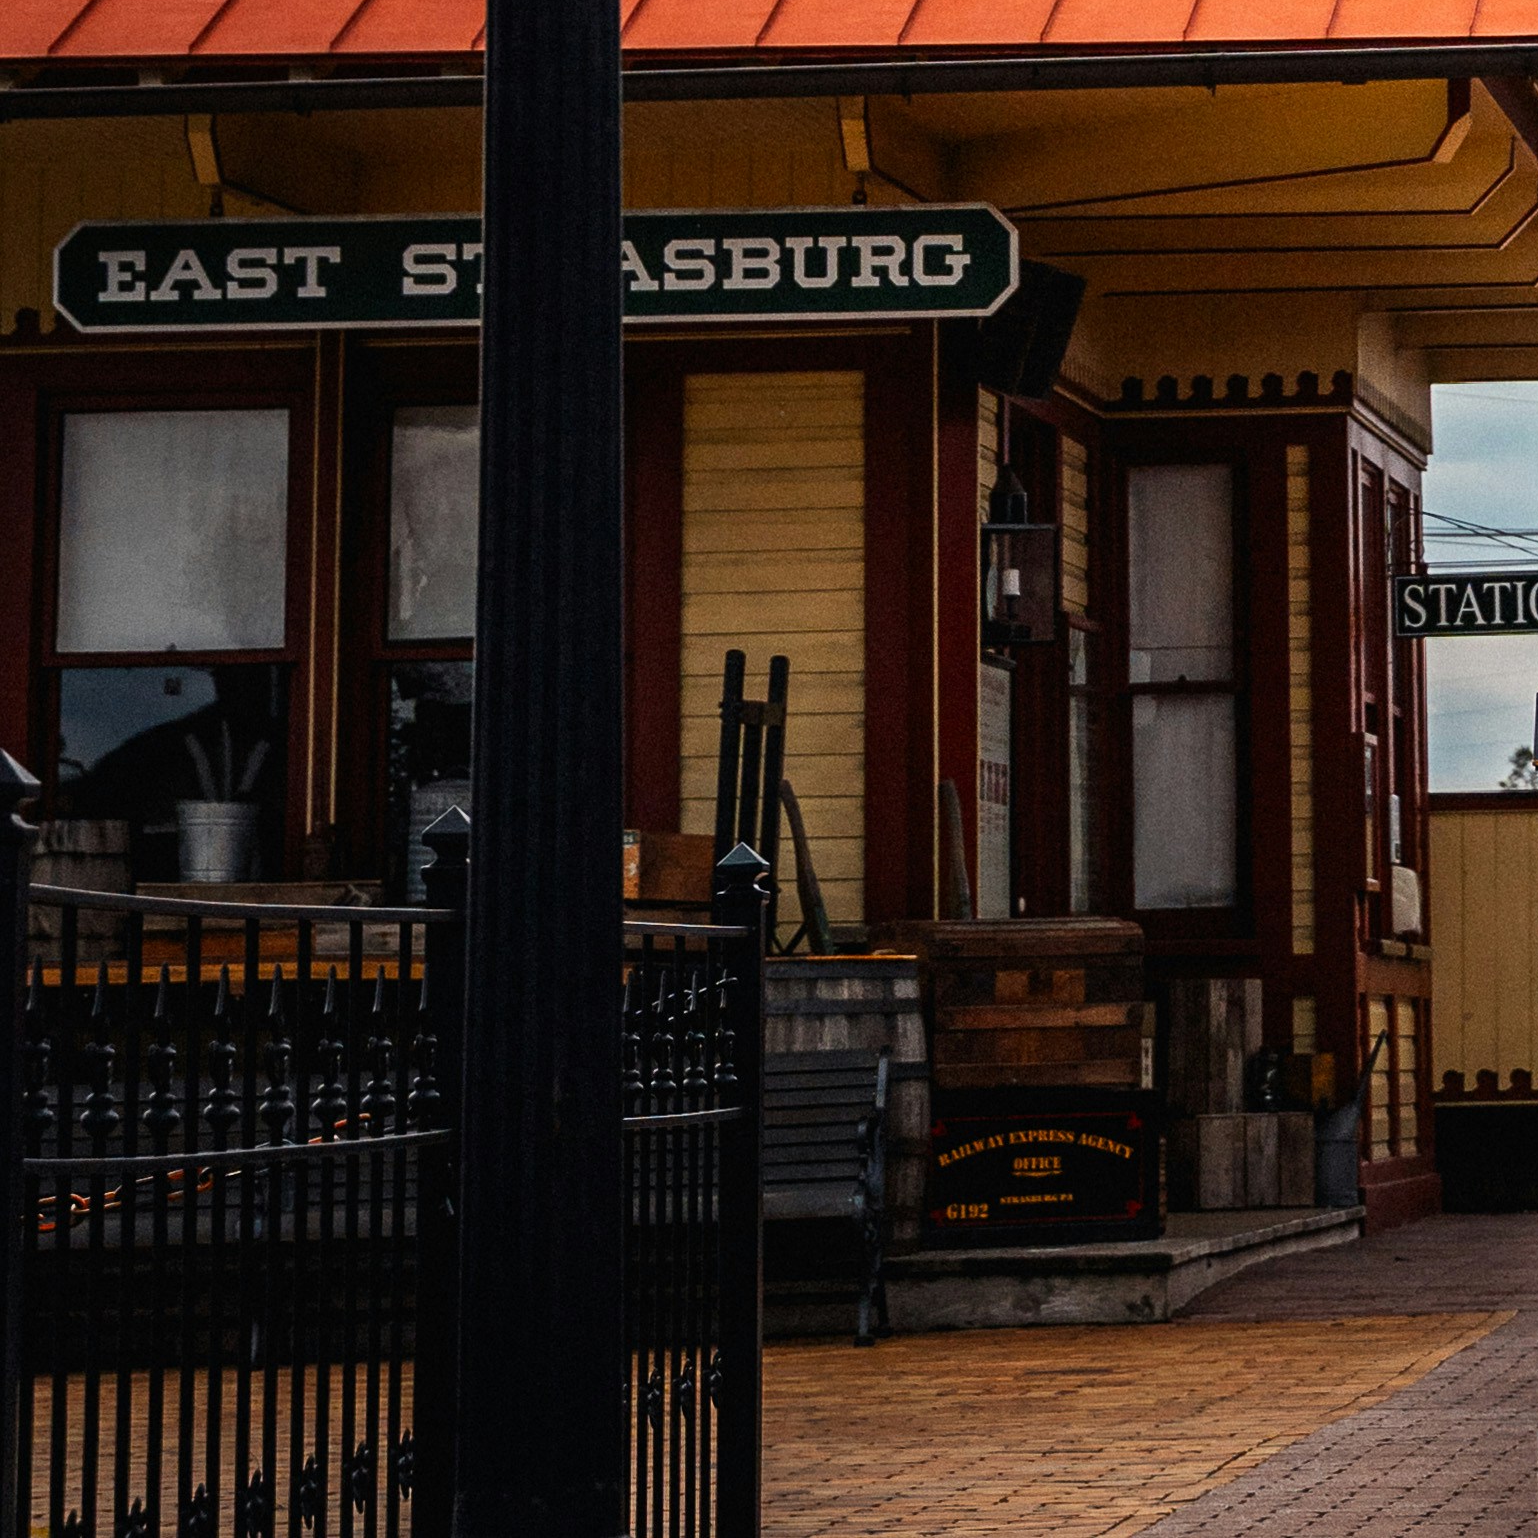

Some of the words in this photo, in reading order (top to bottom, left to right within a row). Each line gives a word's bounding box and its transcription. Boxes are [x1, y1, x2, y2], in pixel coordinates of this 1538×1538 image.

[97, 246, 342, 303] EAST
[402, 233, 971, 297] SASBURG
[938, 1134, 1005, 1167] RAILWAY
[1009, 1129, 1075, 1144] EXPRESS
[1078, 1132, 1134, 1159] AGENCY
[1012, 1156, 1062, 1170] OFFICE
